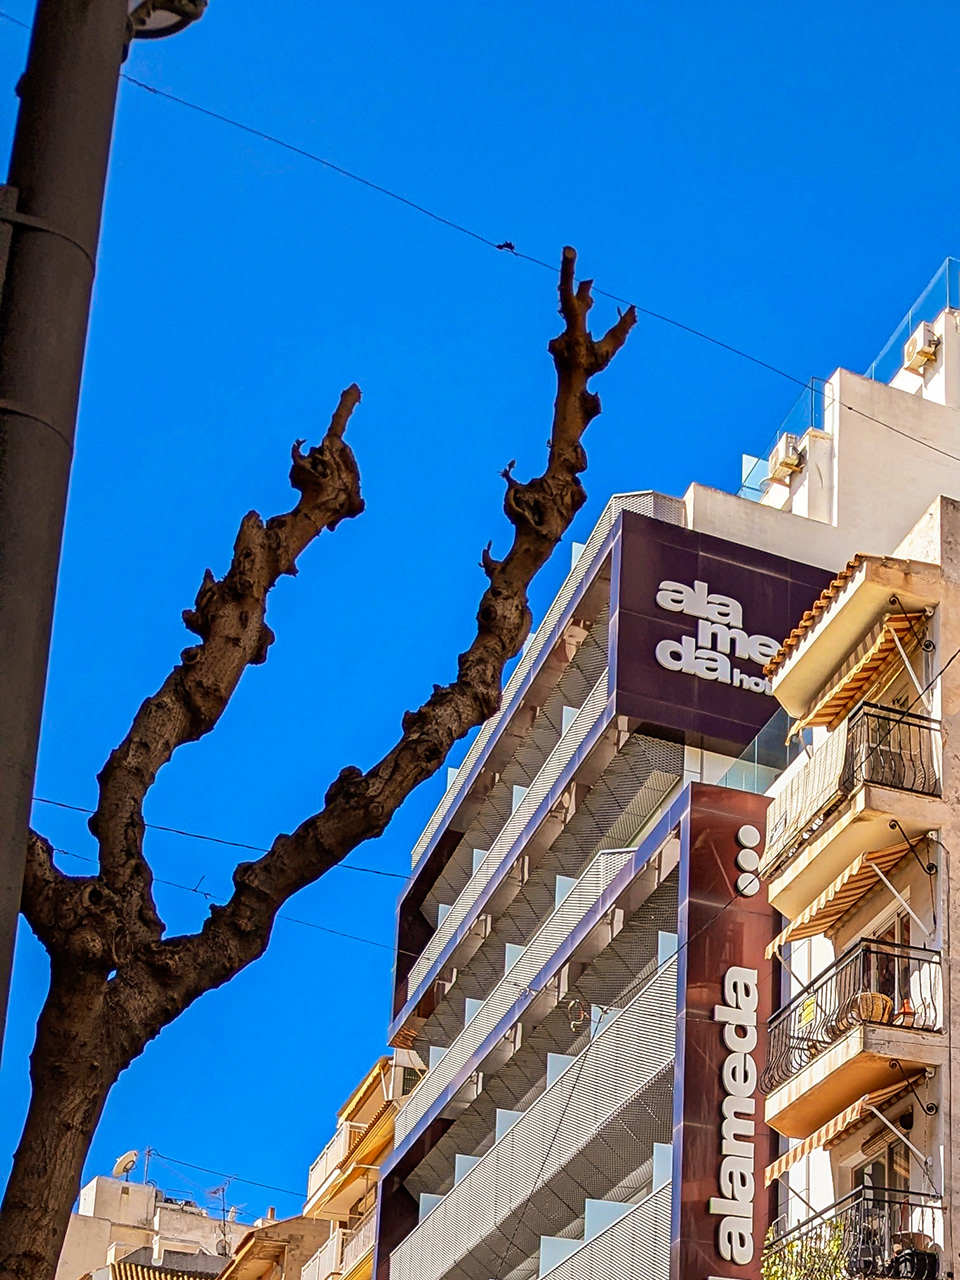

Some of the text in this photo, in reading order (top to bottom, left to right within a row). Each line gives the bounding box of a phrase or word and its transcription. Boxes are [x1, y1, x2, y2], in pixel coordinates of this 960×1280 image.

[655, 579, 743, 628] ala
[654, 635, 732, 685] da
[732, 667, 775, 697] hot
[708, 965, 760, 1267] alameda
